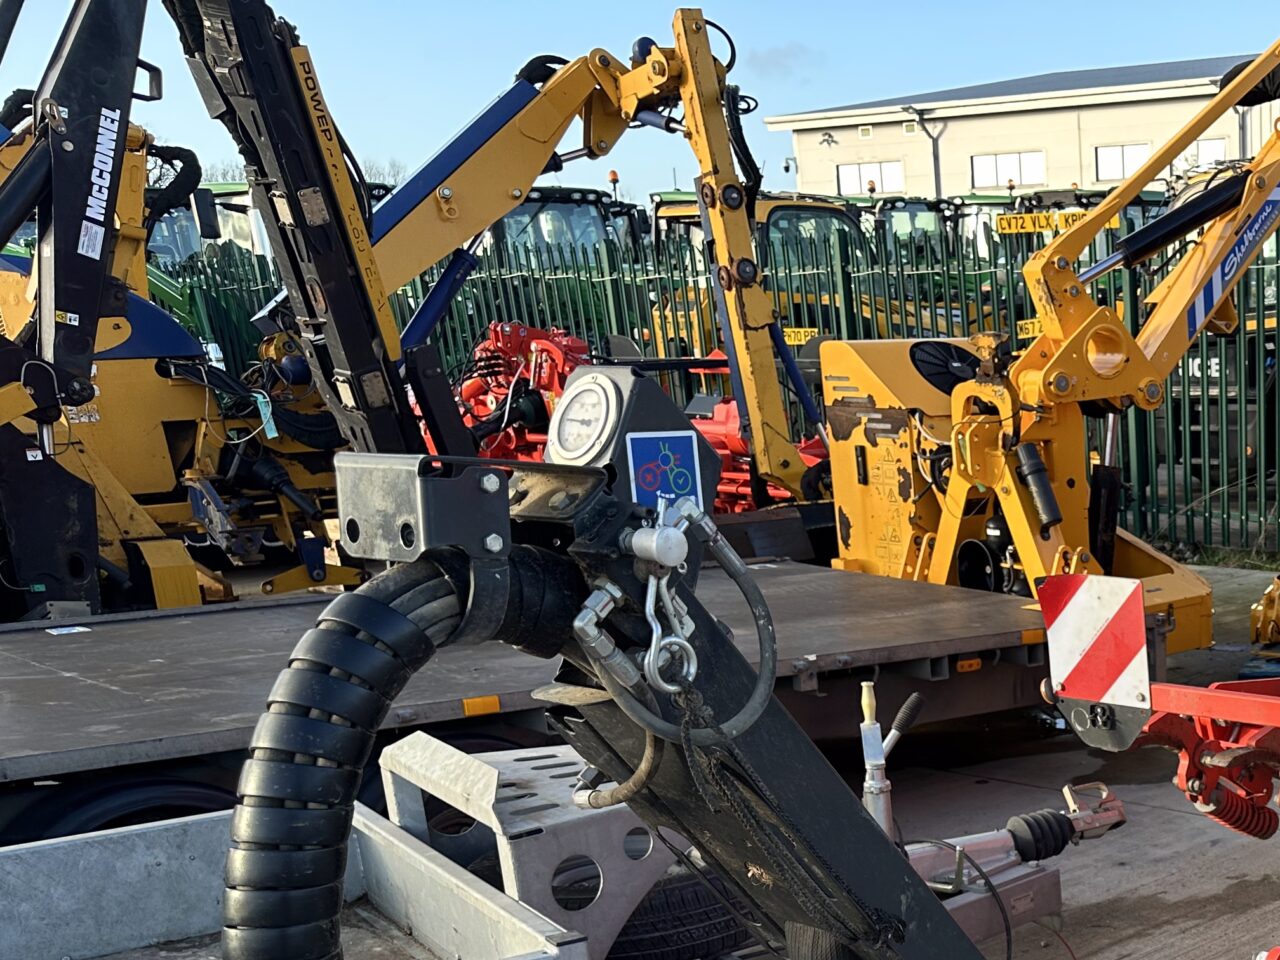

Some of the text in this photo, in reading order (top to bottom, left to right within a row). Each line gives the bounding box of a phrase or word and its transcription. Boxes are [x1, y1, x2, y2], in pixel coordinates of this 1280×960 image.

[999, 214, 1052, 230] CV72 VLX
[1223, 203, 1273, 281] Shelbourne
